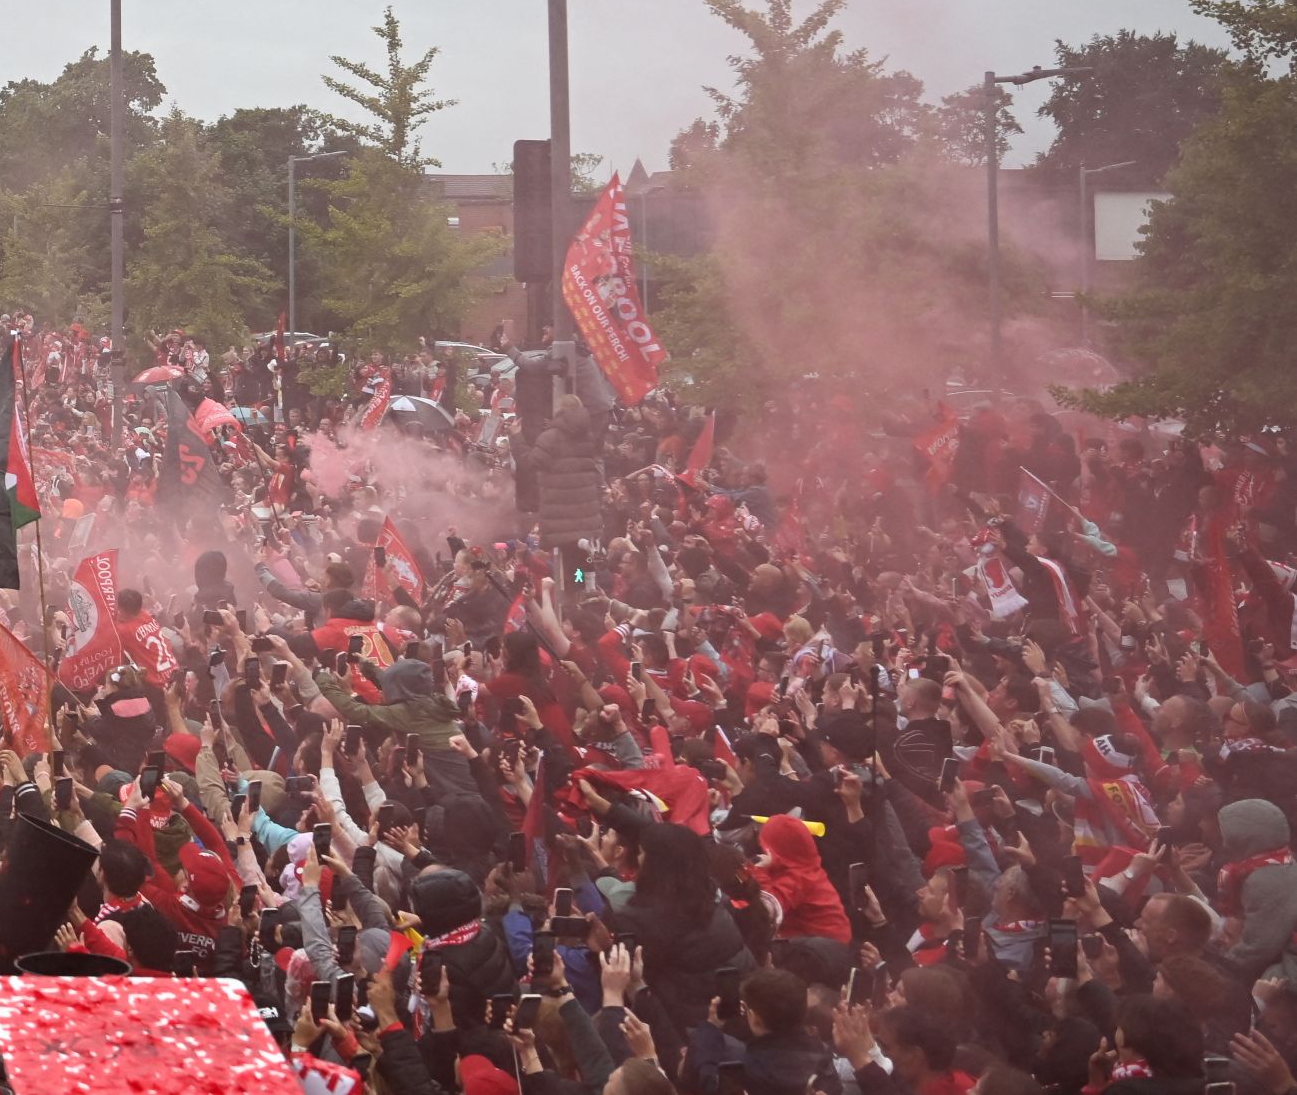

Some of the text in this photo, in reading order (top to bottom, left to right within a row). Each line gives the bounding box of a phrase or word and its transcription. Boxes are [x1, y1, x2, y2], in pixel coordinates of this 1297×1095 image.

[570, 264, 630, 363] BACK ON OUR PERCH!
